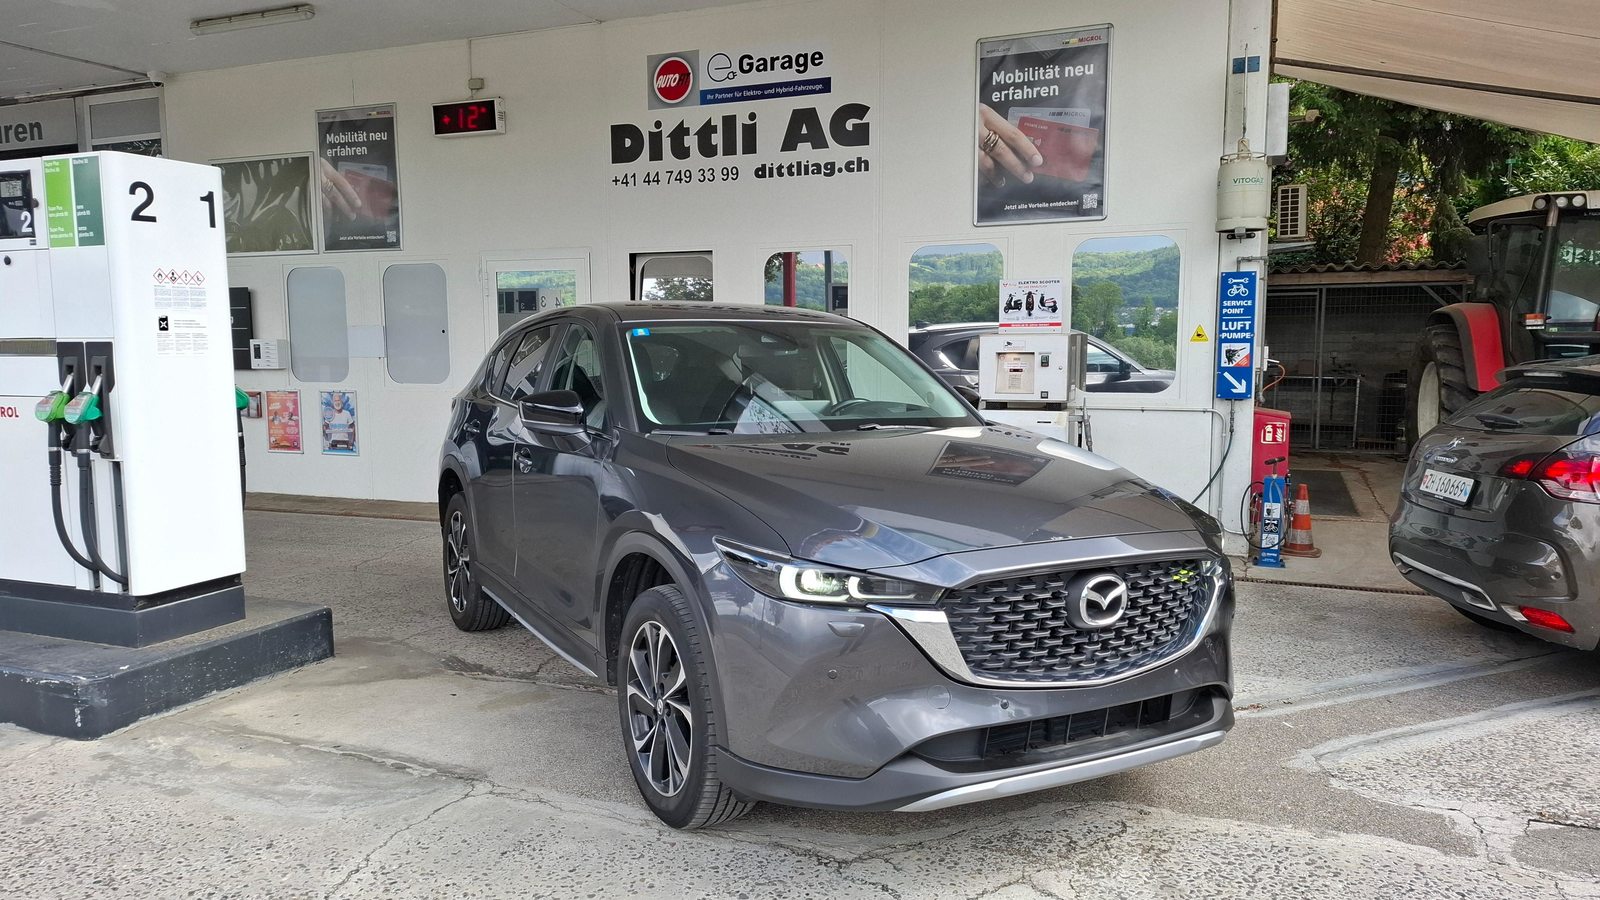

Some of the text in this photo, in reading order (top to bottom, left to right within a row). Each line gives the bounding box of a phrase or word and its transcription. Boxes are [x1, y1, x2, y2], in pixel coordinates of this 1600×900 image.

[738, 50, 824, 75] Garage
[992, 63, 1094, 86] Mobilität neu
[715, 92, 734, 100] Partner
[743, 89, 763, 97] Elektro-
[991, 85, 1059, 103] erfahren
[326, 130, 388, 144] Mobilität neu
[610, 103, 871, 165] Dittli AG
[326, 145, 368, 158] erfahren
[611, 166, 740, 187] +41 44 749 33 99
[754, 157, 870, 179] dittliag.ch
[128, 181, 157, 223] 2
[199, 190, 217, 229] 1
[20, 210, 33, 233] 2
[1222, 299, 1253, 307] SERVICE
[1221, 321, 1251, 331] LUFT
[1425, 473, 1466, 497] ZH 160669
